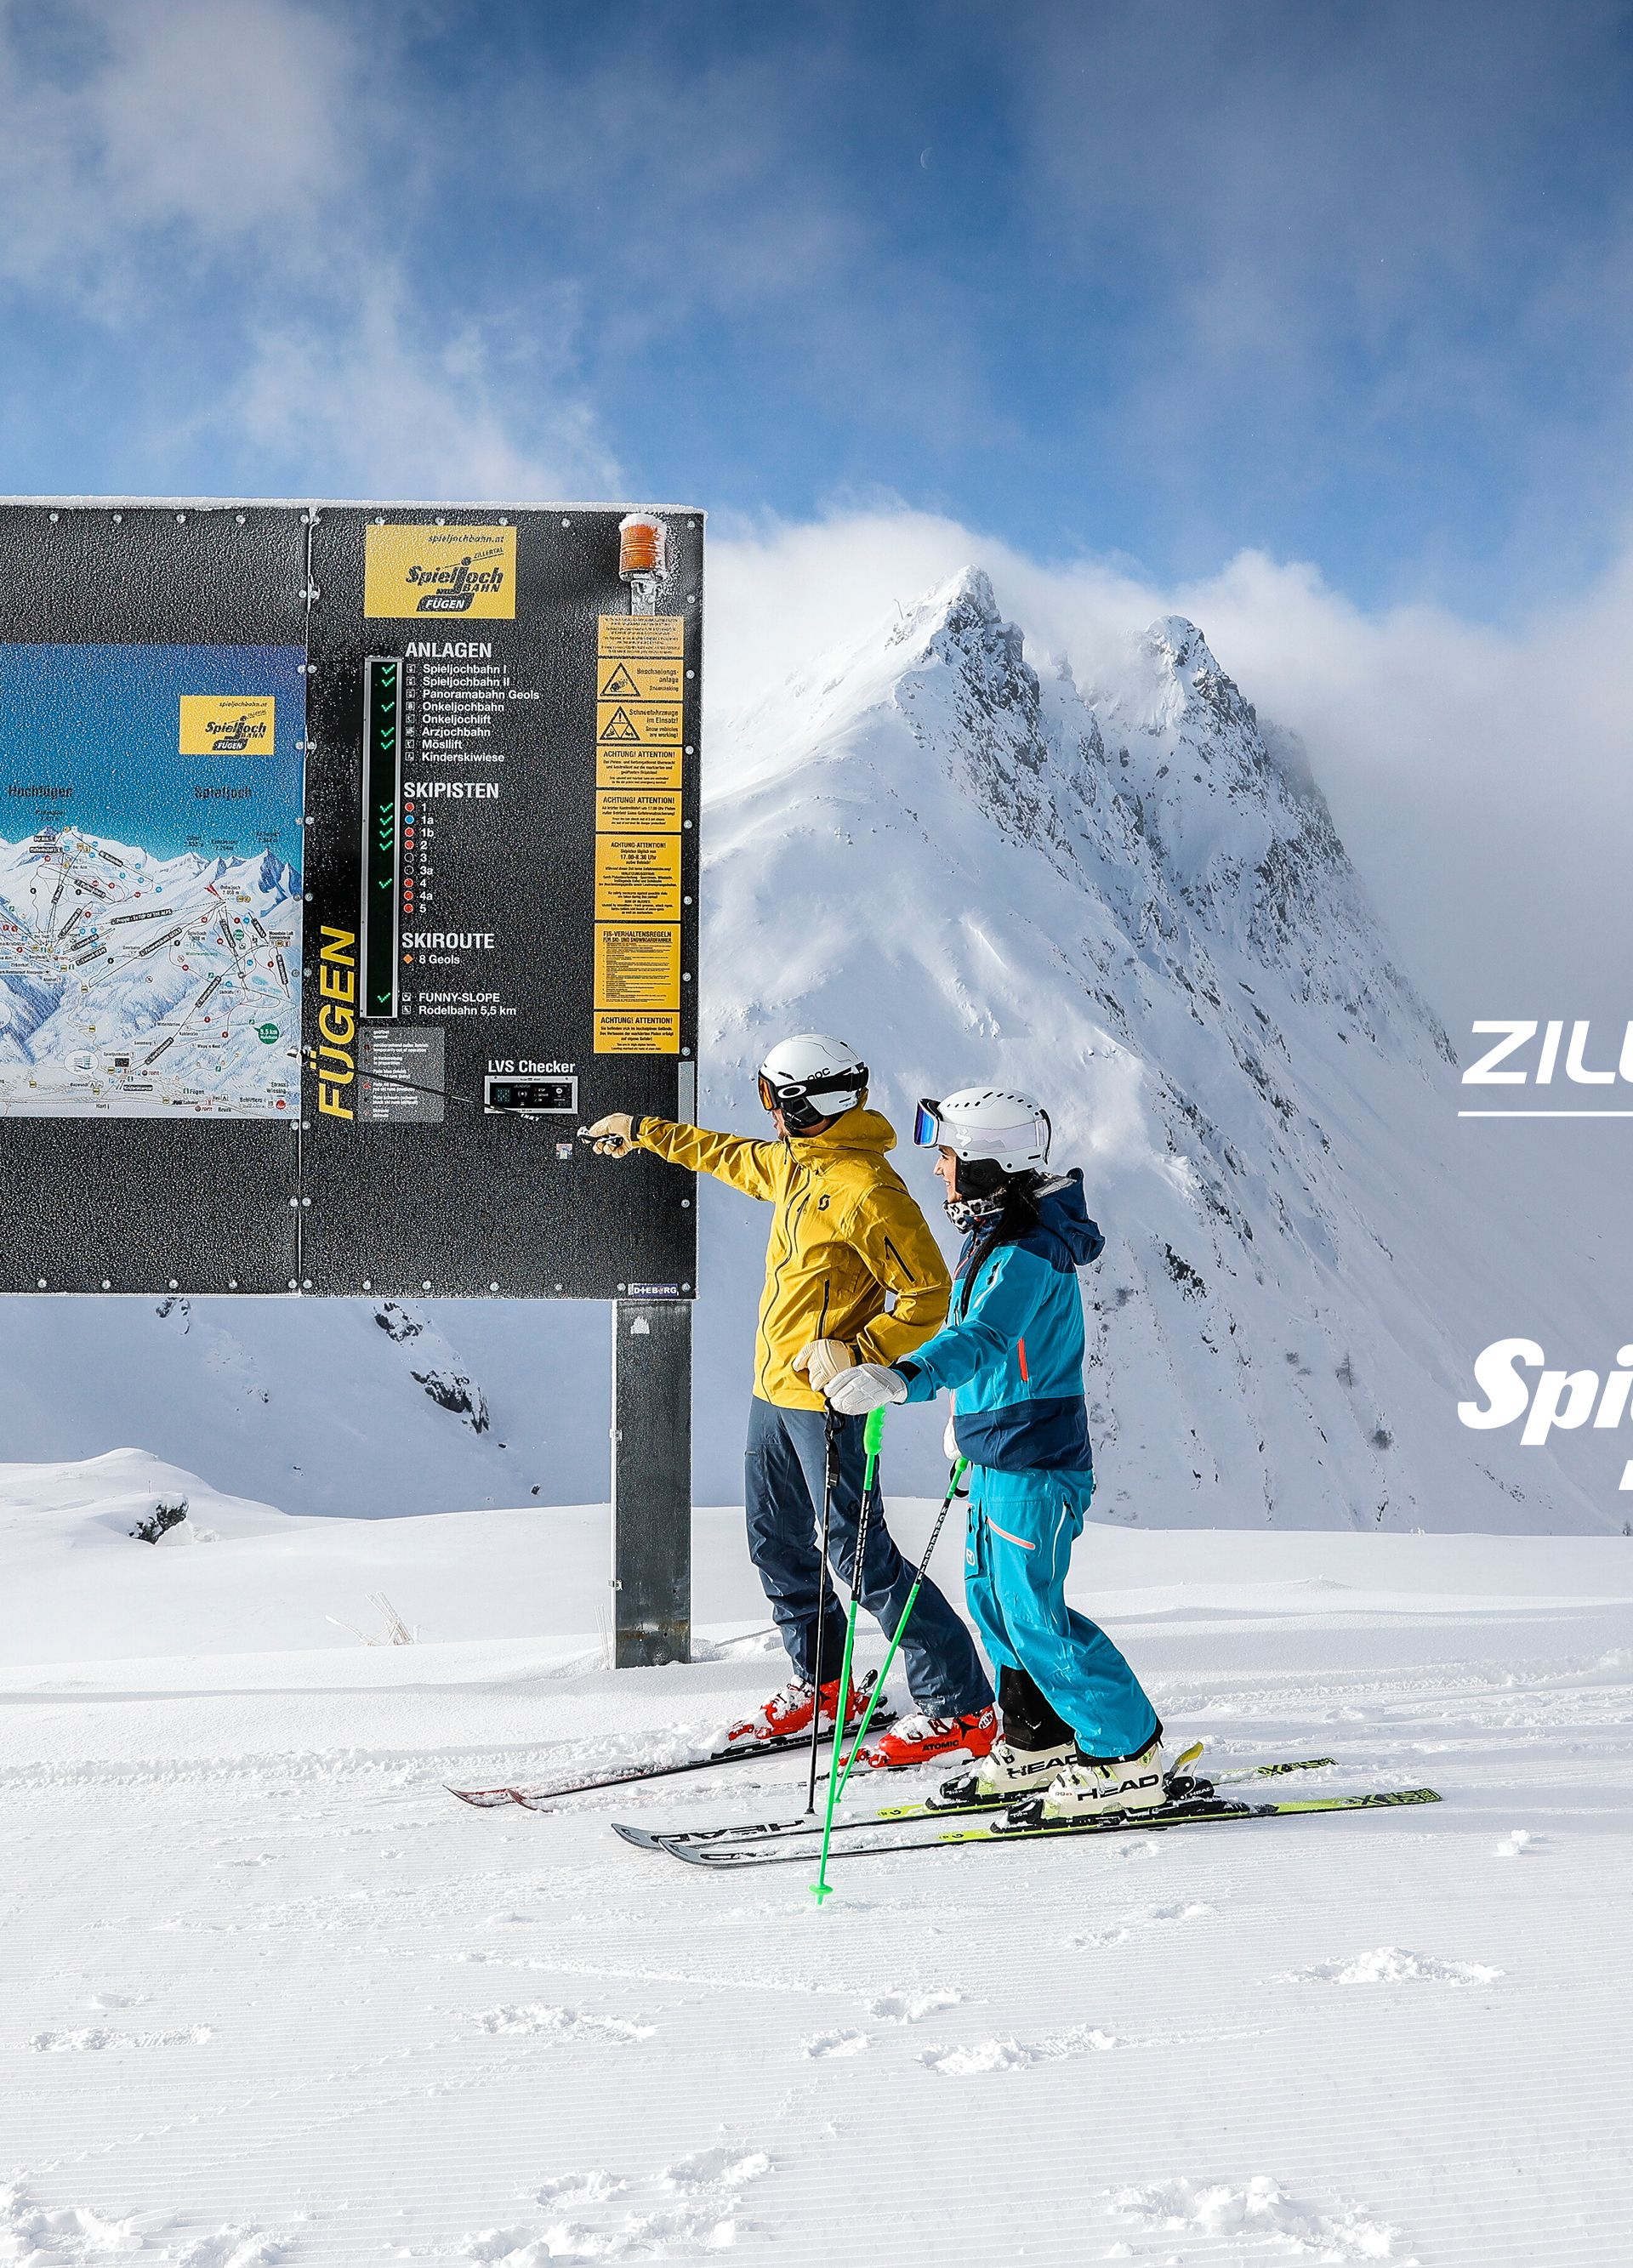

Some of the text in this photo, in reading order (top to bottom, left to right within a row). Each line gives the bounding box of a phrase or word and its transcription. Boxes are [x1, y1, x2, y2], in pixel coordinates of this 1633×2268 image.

[428, 535, 504, 543] spieljochbahn.at
[474, 547, 504, 559] ZILLERTAL
[463, 583, 501, 592] BAHN
[426, 598, 465, 609] FÜGEN
[405, 642, 492, 658] ANLAGEN
[423, 664, 507, 675] Spieljochbahn I
[423, 677, 510, 688] Spieljochbahn II
[423, 690, 540, 700] Panoramabahn Geols
[422, 702, 504, 713] Onkeljochbahn
[422, 714, 491, 725] Onkeljochlift
[422, 727, 491, 738] Arzjochbahn
[422, 739, 462, 749] Mösllift
[422, 752, 504, 762] Kinderskiwiese
[404, 782, 499, 798] SKIPISTEN
[422, 803, 427, 811] 1
[421, 816, 434, 824] 1a
[421, 829, 434, 837] 1b
[420, 841, 427, 850] 2
[420, 853, 427, 862] 3
[420, 866, 433, 875] 3a
[420, 879, 426, 887] 4
[420, 891, 433, 901] 4a
[419, 904, 426, 912] 5
[402, 933, 495, 949] SKIROUTE
[419, 955, 460, 964] 8 Geols
[419, 993, 500, 1002] FUNNY-SLOPE
[419, 1006, 516, 1016] Rodelbahn 5,5 km
[310, 925, 355, 1120] FÜGEN
[488, 1060, 575, 1073] LVS Checker
[922, 1739, 959, 1752] ATOMIC
[1077, 1774, 1159, 1802] HEAD
